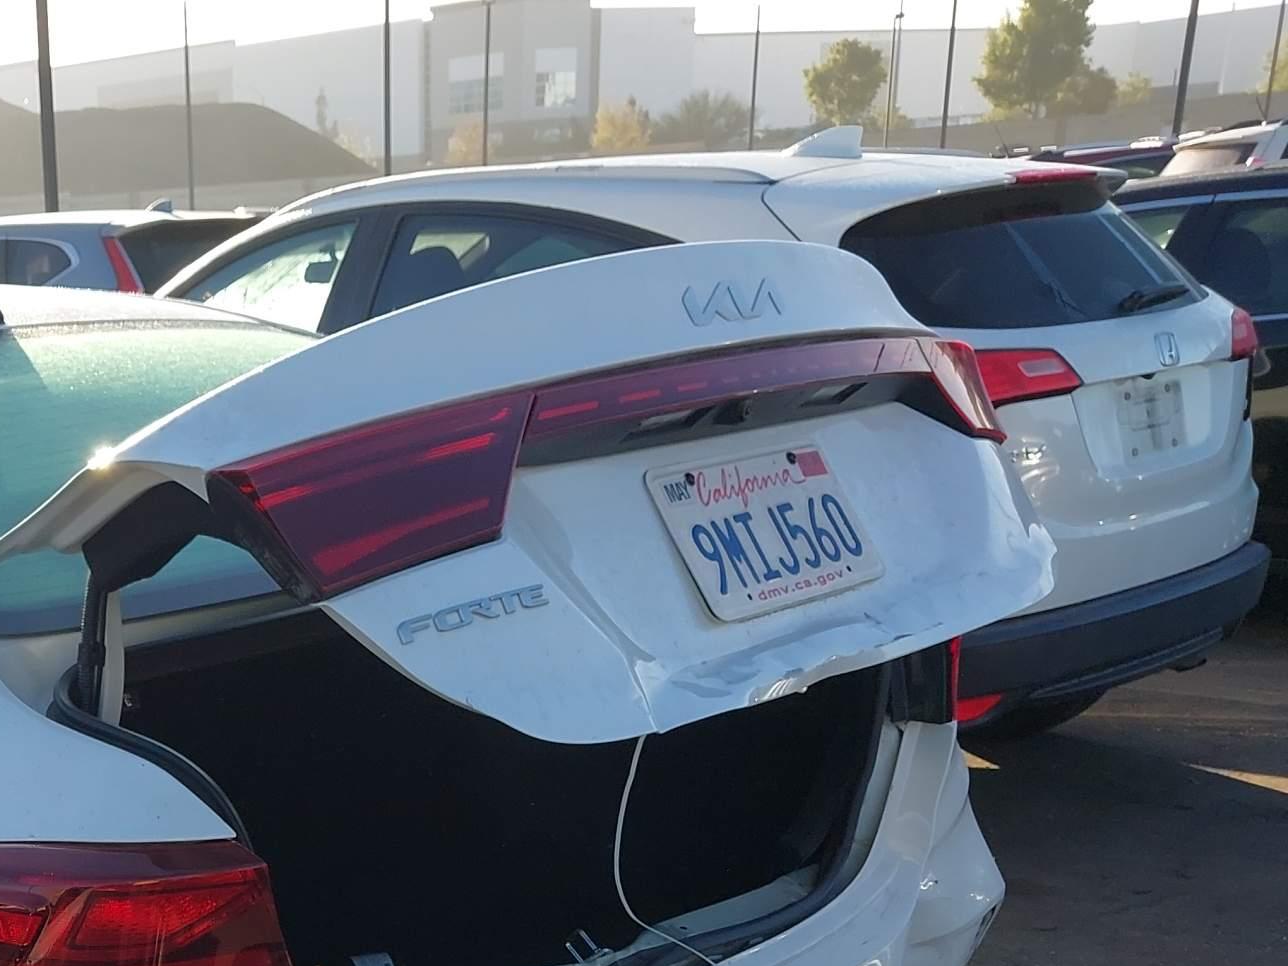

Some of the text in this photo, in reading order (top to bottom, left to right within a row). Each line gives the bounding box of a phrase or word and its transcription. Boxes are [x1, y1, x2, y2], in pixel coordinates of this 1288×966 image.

[681, 277, 784, 328] KIA
[664, 481, 691, 504] MAY
[695, 464, 808, 508] California
[691, 494, 863, 596] 9MIJ560
[757, 567, 845, 602] dmv.ca.gov
[397, 583, 551, 646] FORTE
